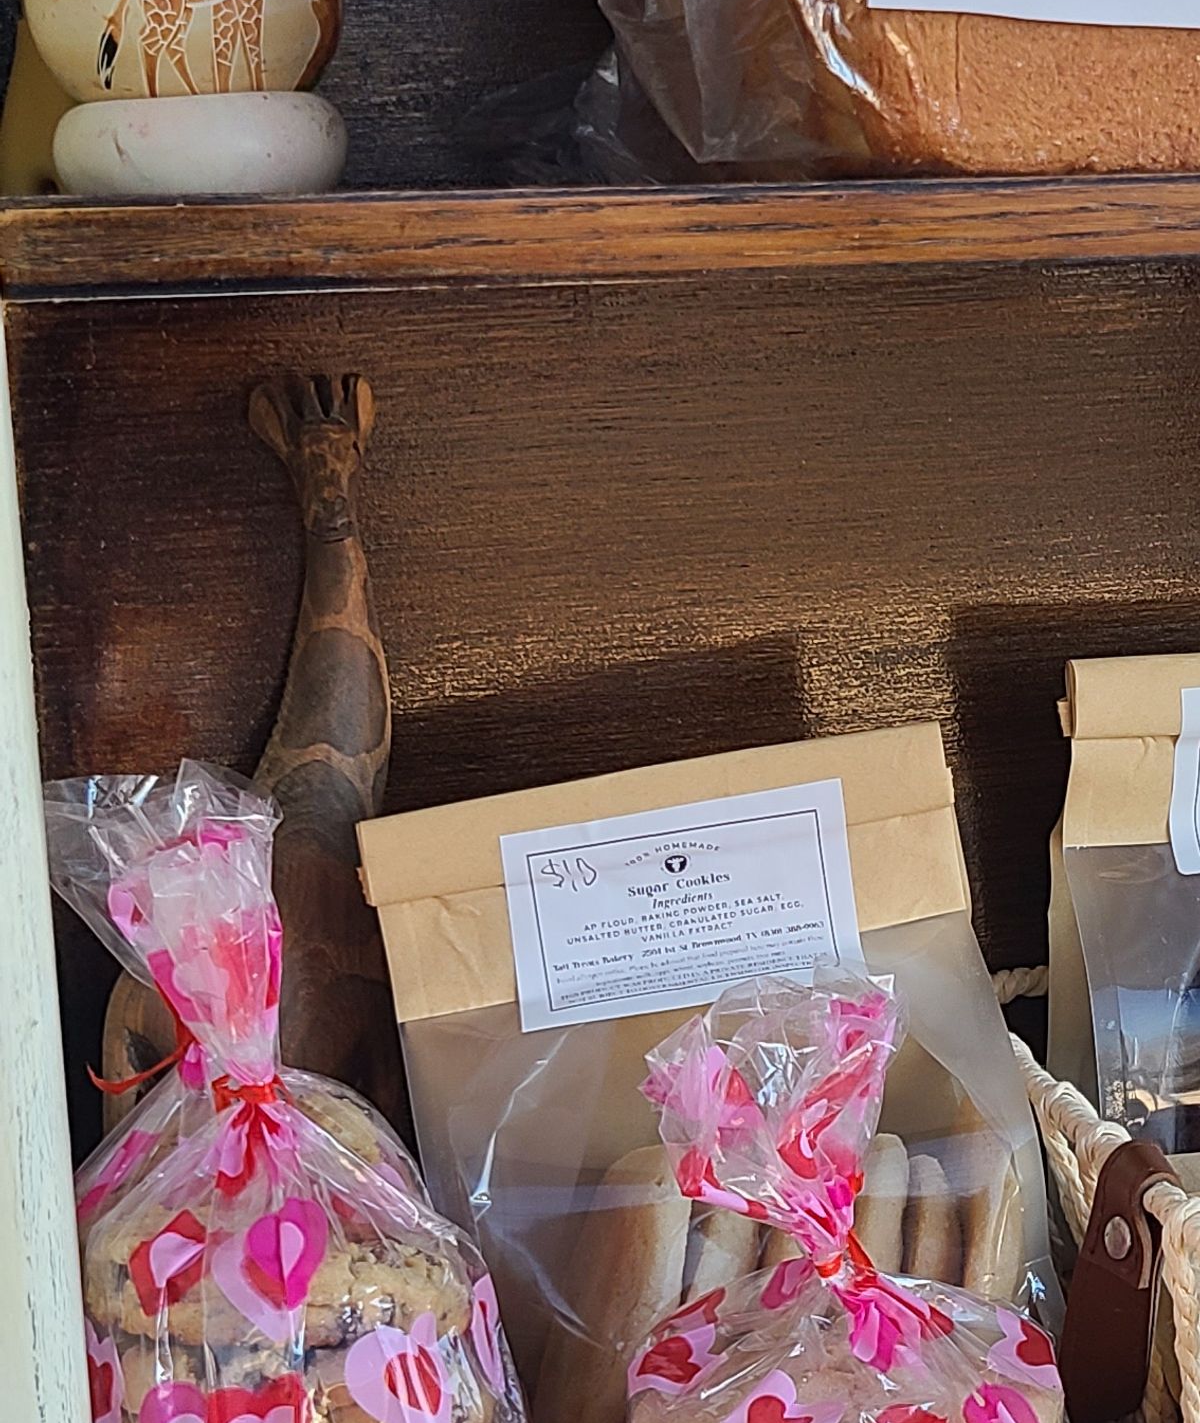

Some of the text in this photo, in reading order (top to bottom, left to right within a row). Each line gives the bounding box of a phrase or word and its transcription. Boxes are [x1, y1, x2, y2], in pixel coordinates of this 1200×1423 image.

[655, 841, 720, 853] HOMEMADE
[626, 872, 730, 898] Sugar Cookies
[651, 891, 713, 910] Ingredients
